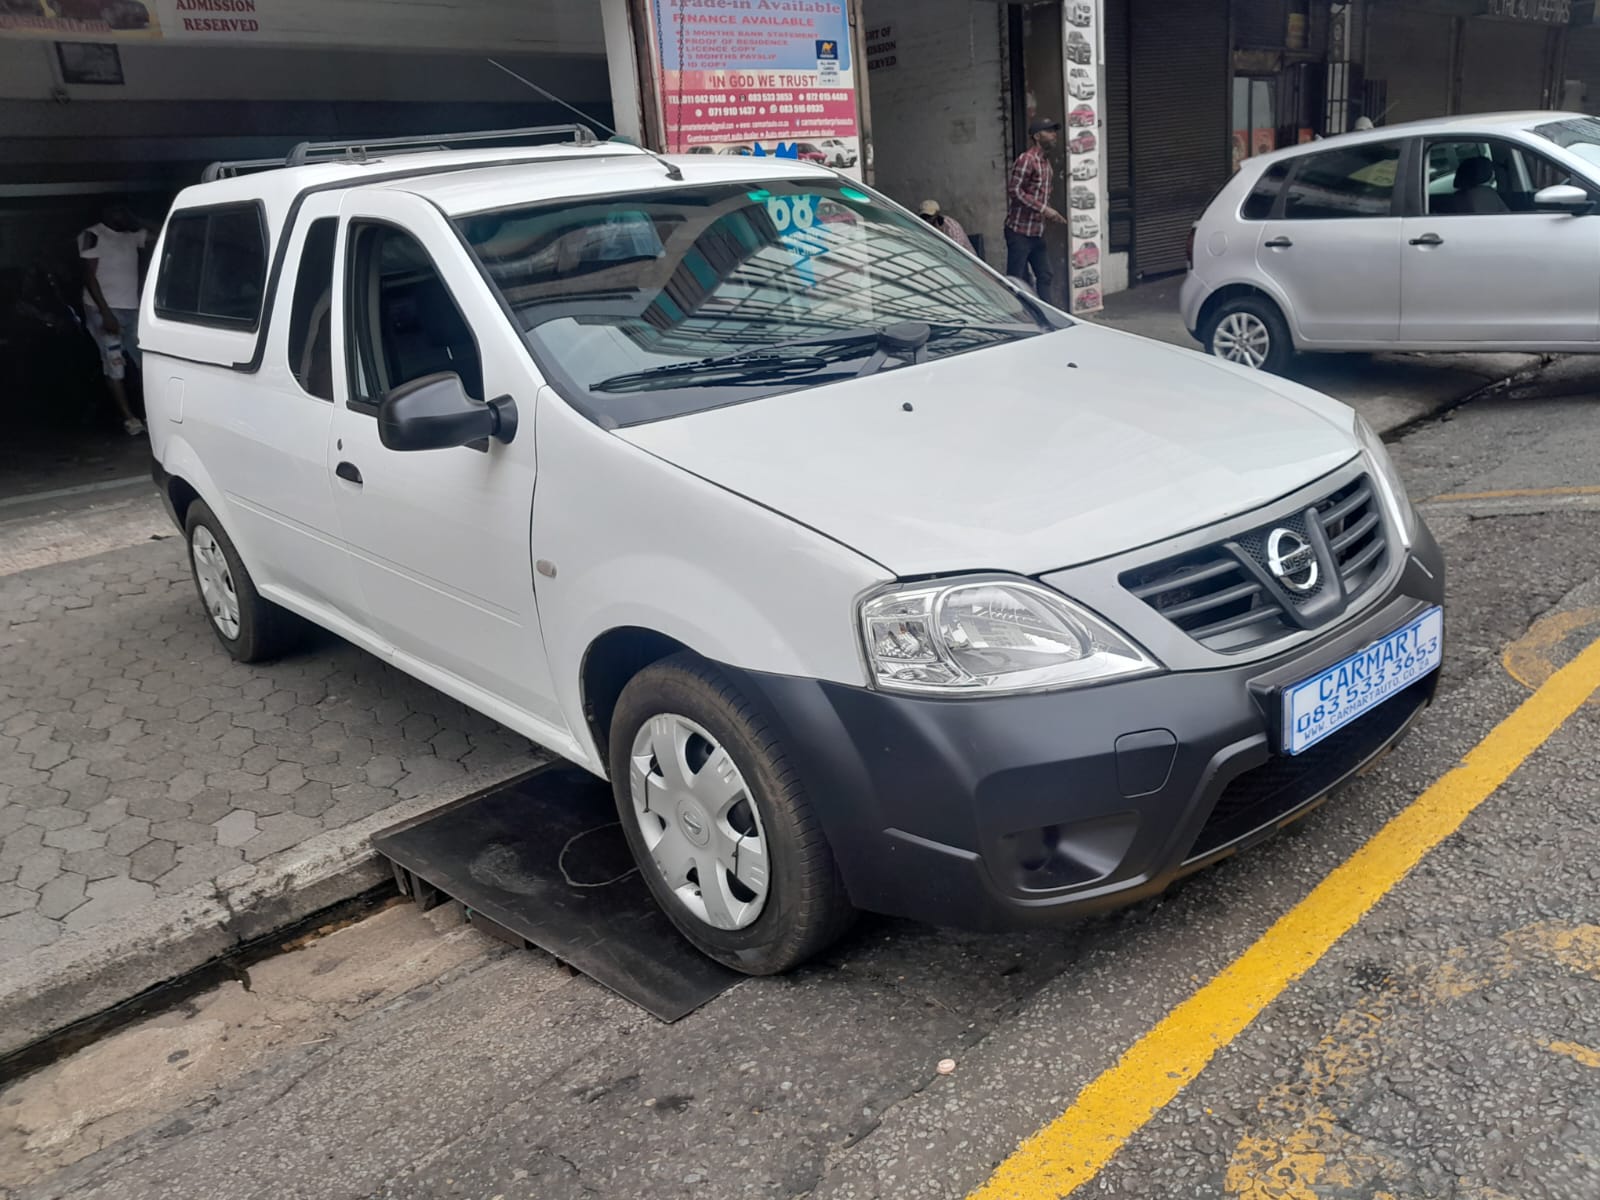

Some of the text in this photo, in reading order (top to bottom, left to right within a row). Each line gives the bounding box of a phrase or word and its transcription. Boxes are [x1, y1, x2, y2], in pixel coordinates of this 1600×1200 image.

[176, 0, 256, 12] ADMISSION
[758, 0, 841, 13] Available
[184, 18, 259, 32] RESERVED
[672, 13, 815, 27] FINANCE AVAILABLE
[729, 75, 754, 87] GOD
[758, 75, 775, 87] WE
[708, 107, 722, 116] 071
[1319, 623, 1421, 701] CARMART
[1297, 636, 1438, 733] 083 533 3653
